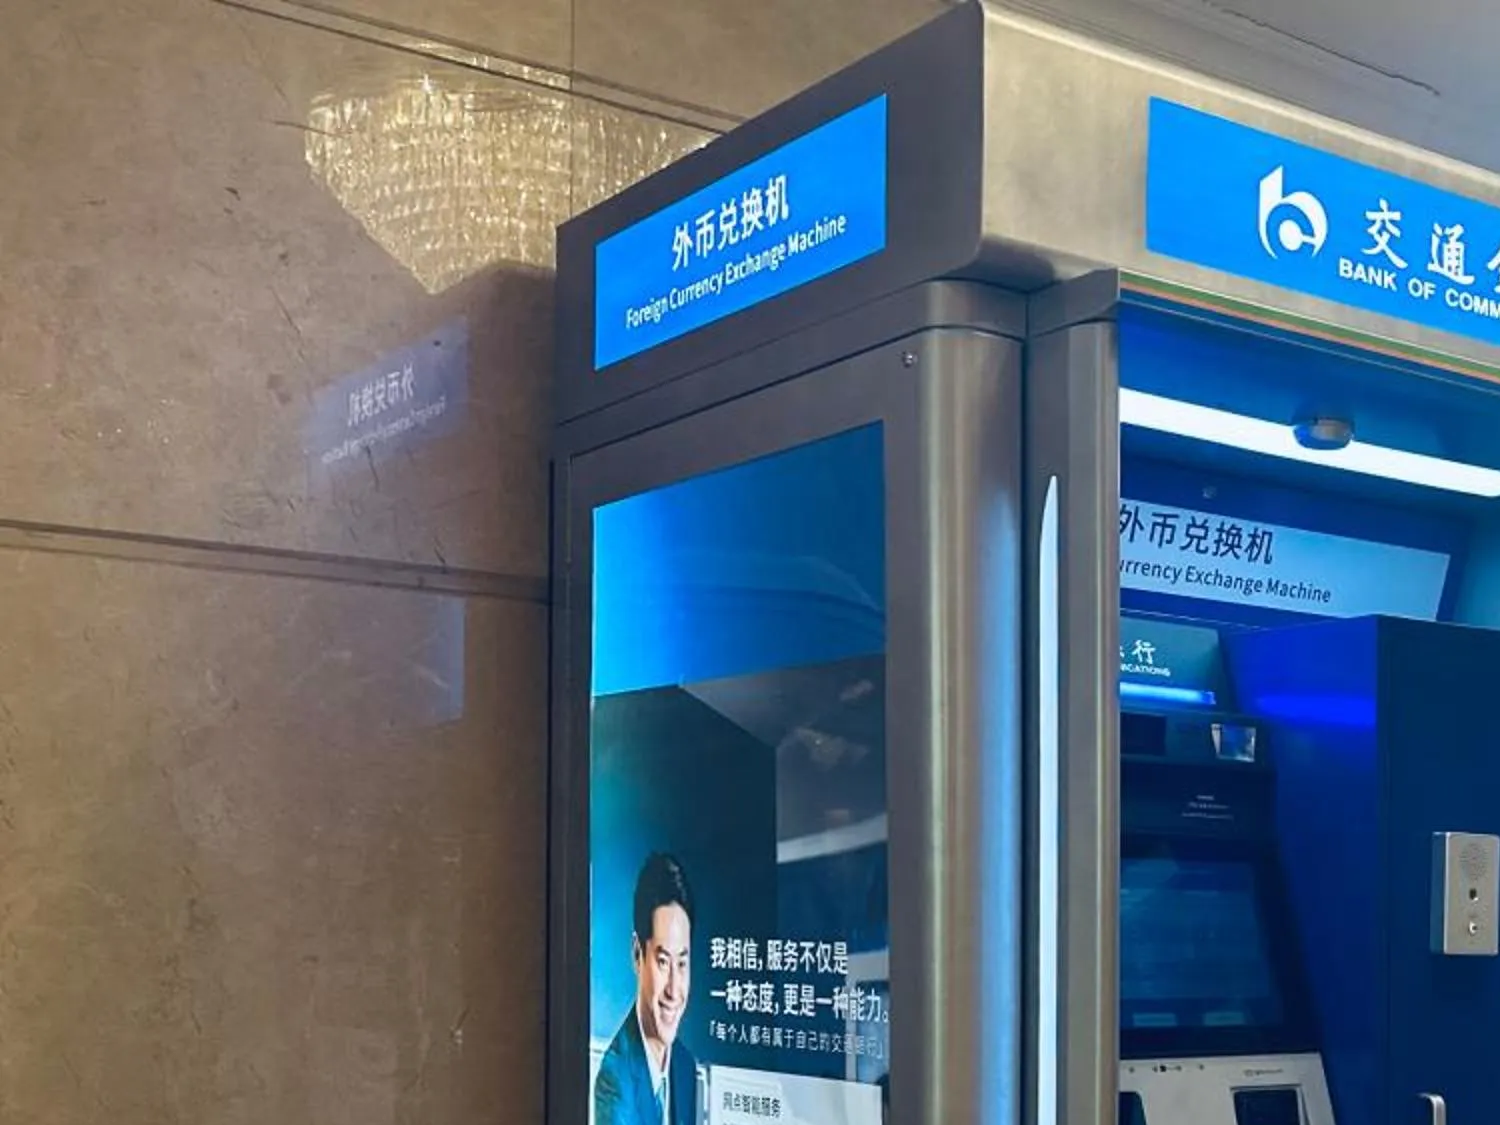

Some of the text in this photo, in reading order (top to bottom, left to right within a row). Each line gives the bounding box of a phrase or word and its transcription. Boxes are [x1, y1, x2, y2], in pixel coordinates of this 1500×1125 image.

[672, 175, 789, 271] 外币兑换机
[625, 214, 847, 329] Foreign Currency Exchange Machine
[1339, 258, 1397, 292] BANK
[1409, 278, 1436, 300] OF
[1120, 503, 1273, 565] 外币兑换机
[1120, 560, 1331, 603] rrency Exchange Machine
